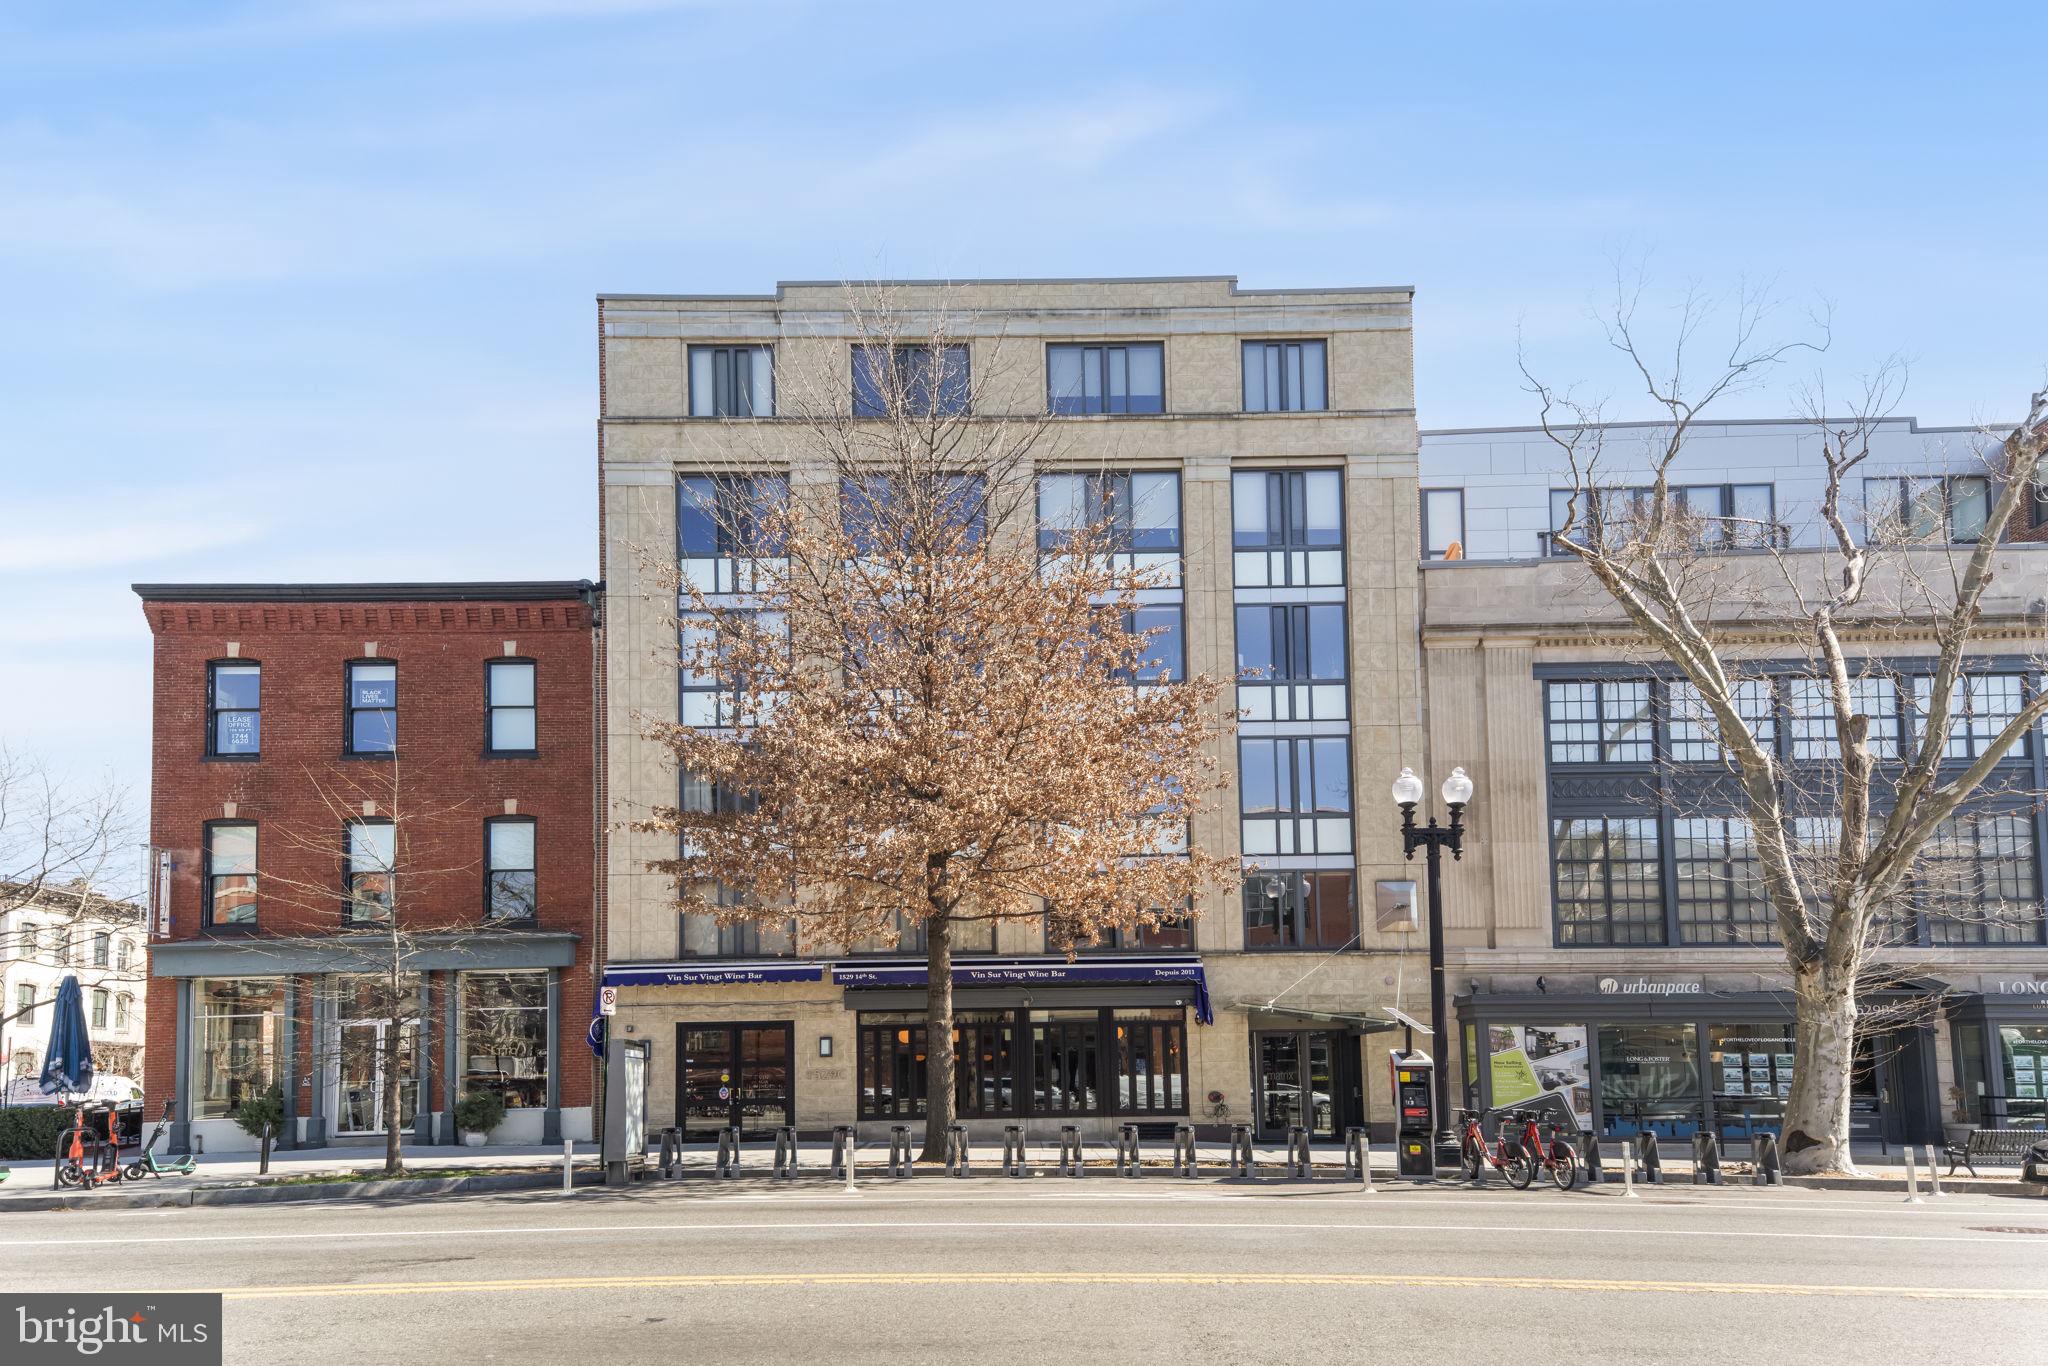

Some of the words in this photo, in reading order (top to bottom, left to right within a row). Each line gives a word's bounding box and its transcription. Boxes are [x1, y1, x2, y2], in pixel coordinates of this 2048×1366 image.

[666, 973, 682, 981] Vin
[683, 973, 698, 981] Sur
[700, 973, 723, 981] Vingt
[724, 972, 746, 980] Wine
[970, 971, 986, 979] Vin
[987, 971, 1002, 979] Sur
[1003, 970, 1026, 979] Vingt
[1028, 970, 1050, 978] Wine
[1051, 970, 1067, 978] Bar
[1155, 969, 1179, 977] Depuis
[1622, 978, 1700, 996] urbanpace
[1267, 1071, 1294, 1080] matrix
